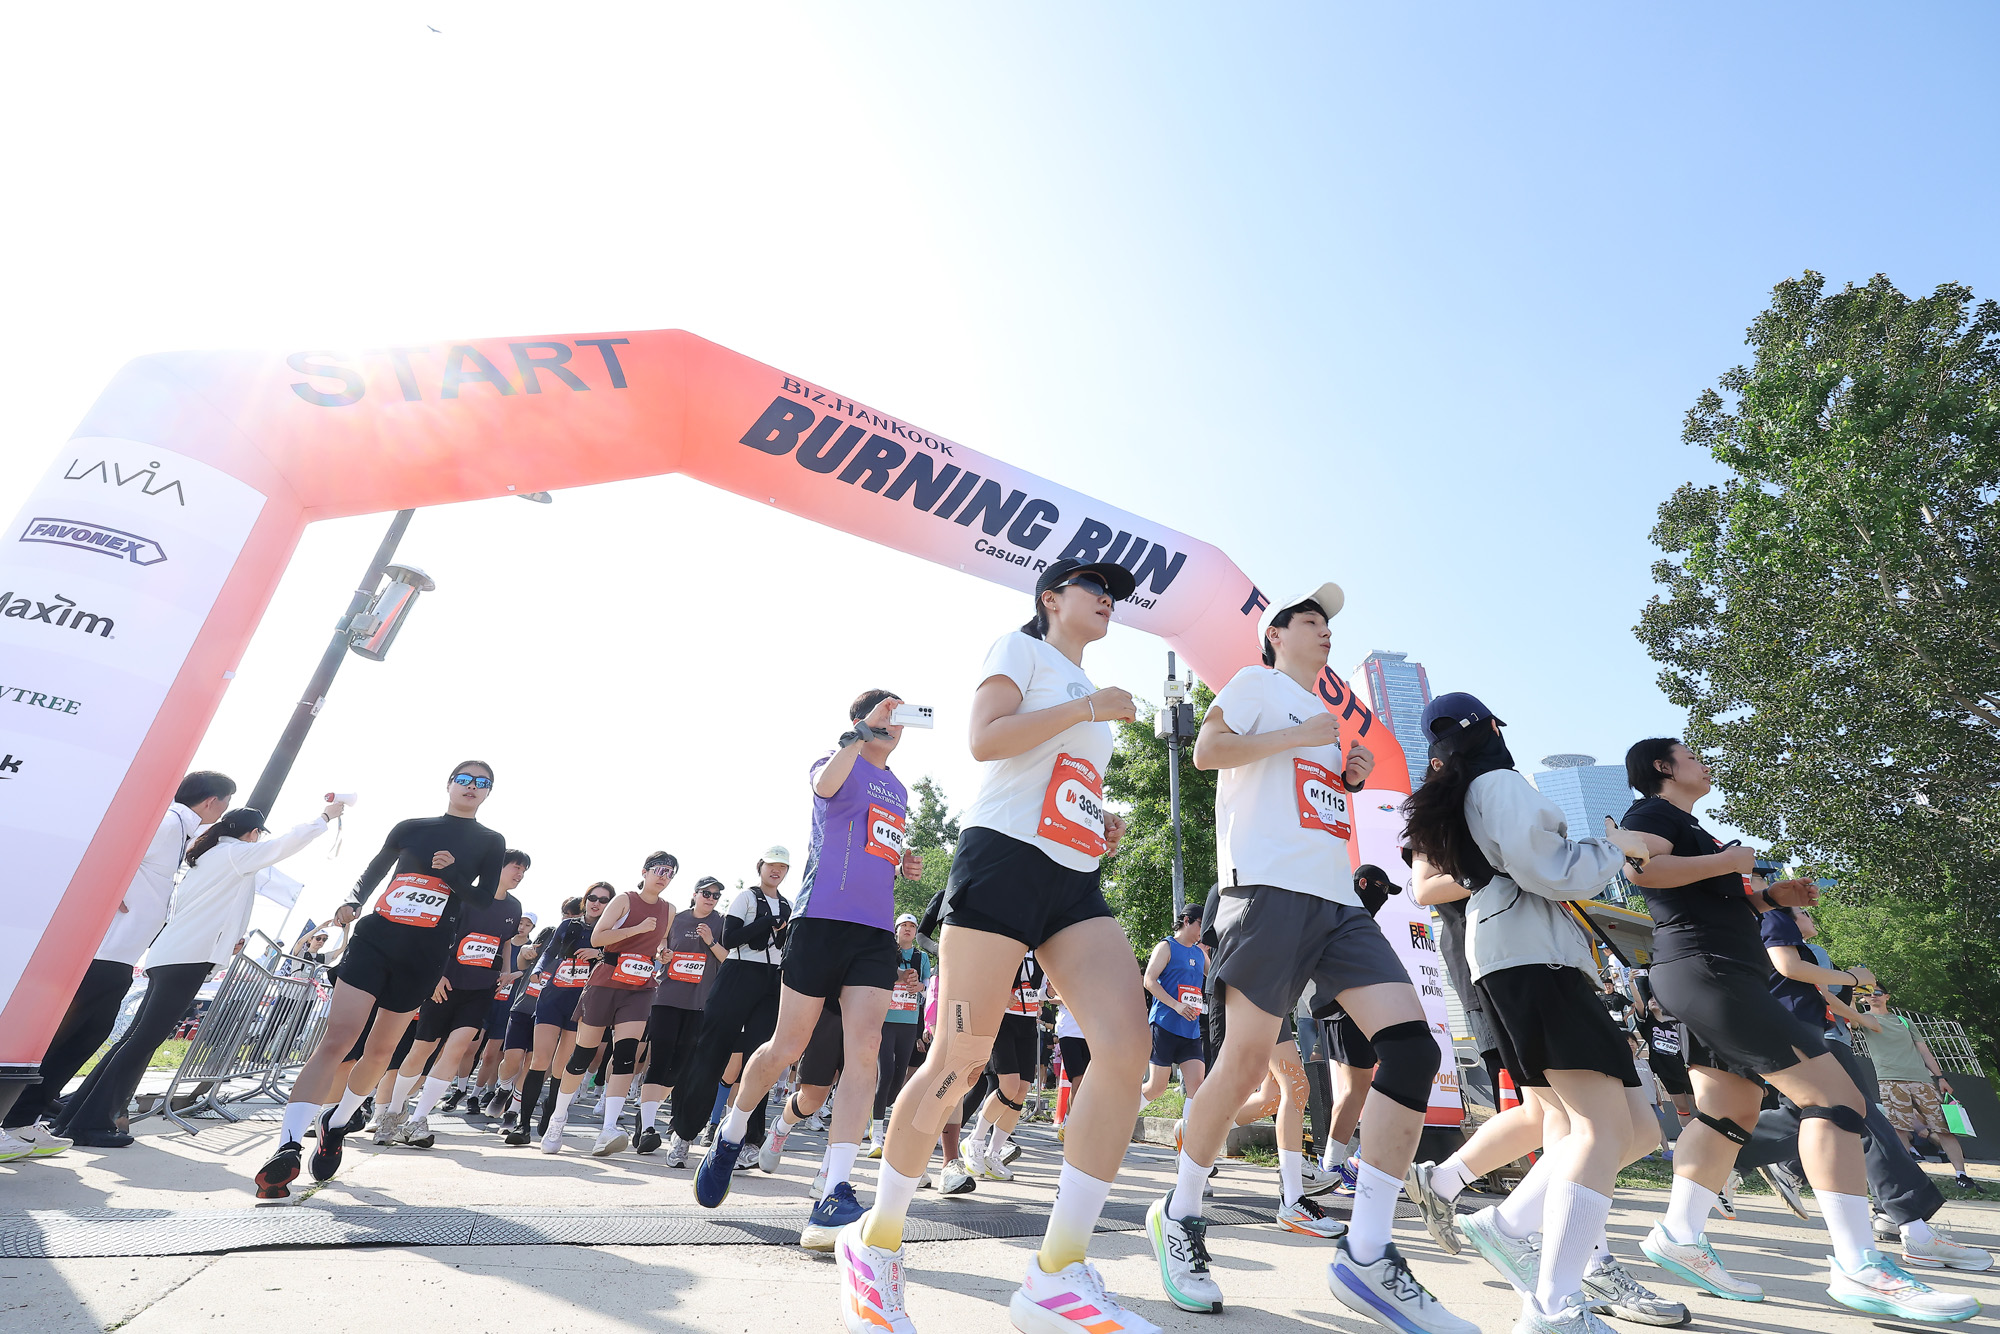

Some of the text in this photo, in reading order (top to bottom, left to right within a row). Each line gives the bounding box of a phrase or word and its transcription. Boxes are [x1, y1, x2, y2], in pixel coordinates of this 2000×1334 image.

[287, 338, 630, 407] START
[739, 396, 1187, 596] BURNING RUN
[30, 522, 146, 564] FAVONEX
[974, 538, 1032, 568] Casual
[1125, 592, 1157, 610] tival
[869, 782, 902, 803] OSAKA
[1066, 789, 1076, 804] W
[1310, 788, 1345, 812] M 1113
[876, 826, 902, 845] M 165
[394, 891, 447, 908] W 4307
[1412, 936, 1437, 953] KIND
[632, 963, 653, 973] 4349
[683, 962, 705, 970] 4507
[1419, 965, 1439, 978] TOUS
[1421, 984, 1443, 998] JOURS
[936, 1070, 958, 1099] ROCKTAPE
